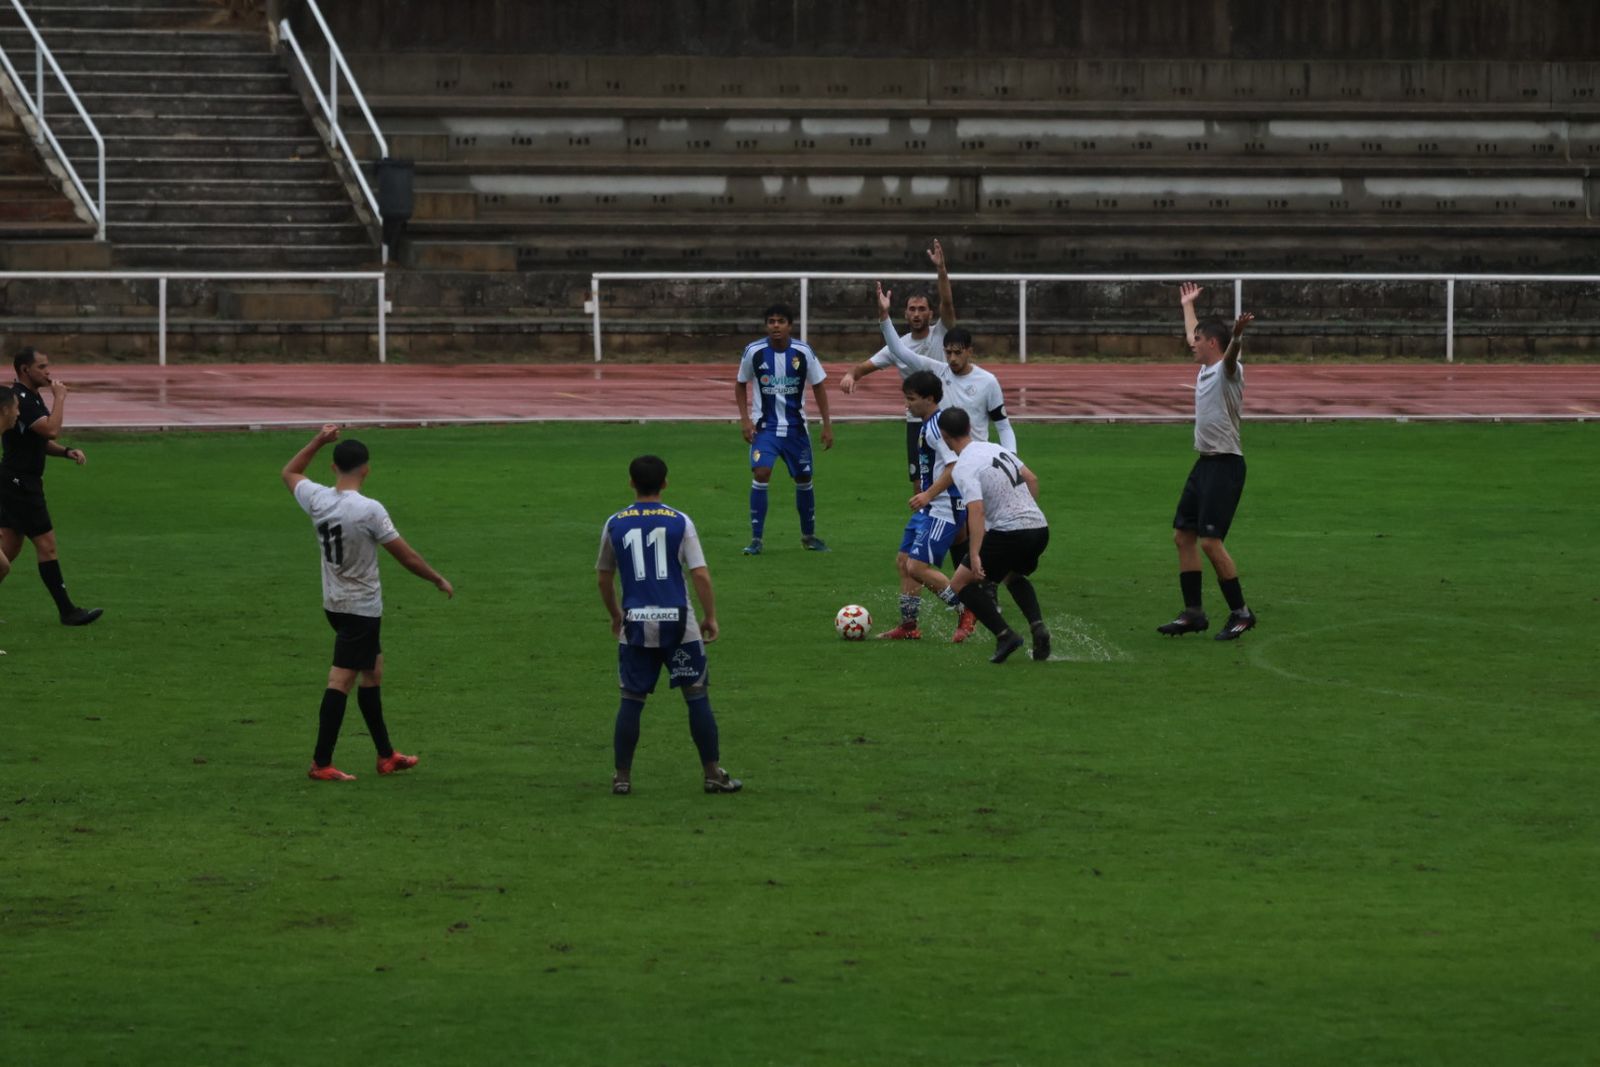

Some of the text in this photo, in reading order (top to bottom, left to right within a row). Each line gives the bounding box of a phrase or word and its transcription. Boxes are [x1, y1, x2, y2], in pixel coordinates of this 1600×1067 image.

[992, 451, 1027, 488] 12
[318, 521, 343, 565] 11
[622, 526, 668, 582] 11
[634, 612, 678, 620] VALCARCE
